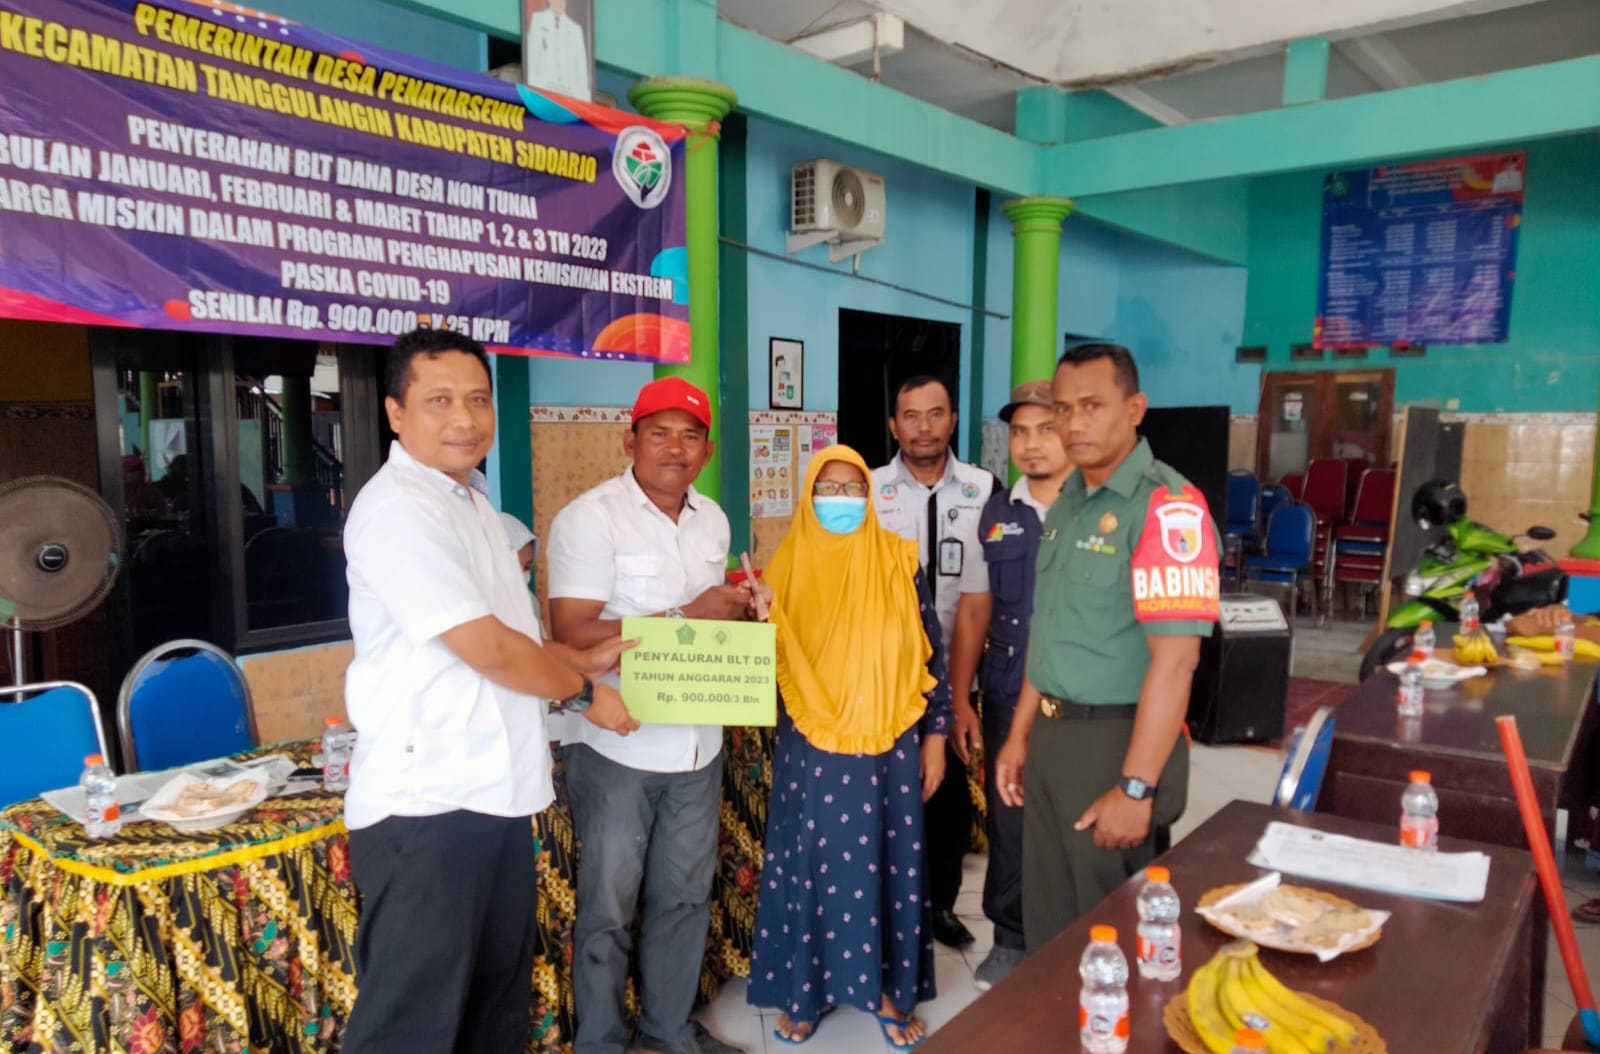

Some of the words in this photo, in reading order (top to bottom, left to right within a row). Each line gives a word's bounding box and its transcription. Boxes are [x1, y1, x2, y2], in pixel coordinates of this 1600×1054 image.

[0, 10, 198, 92] KECAMATAN
[200, 64, 394, 138] TANGGULANGIN
[394, 112, 514, 165] KABUPATEN
[515, 139, 598, 184] SIDOARJO
[134, 2, 313, 80] PEMERINTAH
[312, 53, 378, 97] DESA
[377, 70, 526, 132] PENATARSEWU
[98, 150, 218, 203] JANUARI,
[219, 173, 332, 220] FEBRUARI
[335, 198, 353, 222] &
[354, 198, 423, 235] MARET
[424, 210, 484, 243] TAHAP
[502, 223, 516, 248] 2
[517, 229, 532, 251] &
[532, 228, 547, 252] 3
[547, 229, 570, 256] TH
[571, 233, 608, 262] 2023
[127, 114, 290, 174] PENYERAHAN
[294, 148, 333, 182] BLT
[335, 154, 393, 194] DANA
[395, 168, 444, 205] DESA
[446, 180, 484, 212] NON
[486, 187, 538, 220] TUNAI
[77, 190, 186, 236] MISKIN
[189, 208, 275, 248] DALAM
[277, 221, 387, 264] PROGRAM
[387, 239, 522, 281] PENGHAPUSAN
[523, 257, 609, 292] KEMISKINAN
[611, 271, 674, 301] EKSTREM
[281, 260, 356, 295] PASKA
[357, 272, 450, 306] COVID-19
[188, 289, 283, 325] SENILAI
[286, 299, 325, 331] Rp.
[471, 317, 511, 344] KPM
[633, 672, 674, 681] TAHUN
[678, 673, 741, 683] ANGGARAN
[744, 675, 769, 684] 2023
[634, 651, 723, 664] PENYALURAN
[727, 655, 750, 665] BLT
[754, 657, 771, 665] DD
[657, 692, 677, 703] Rp.
[743, 695, 759, 704] Bln
